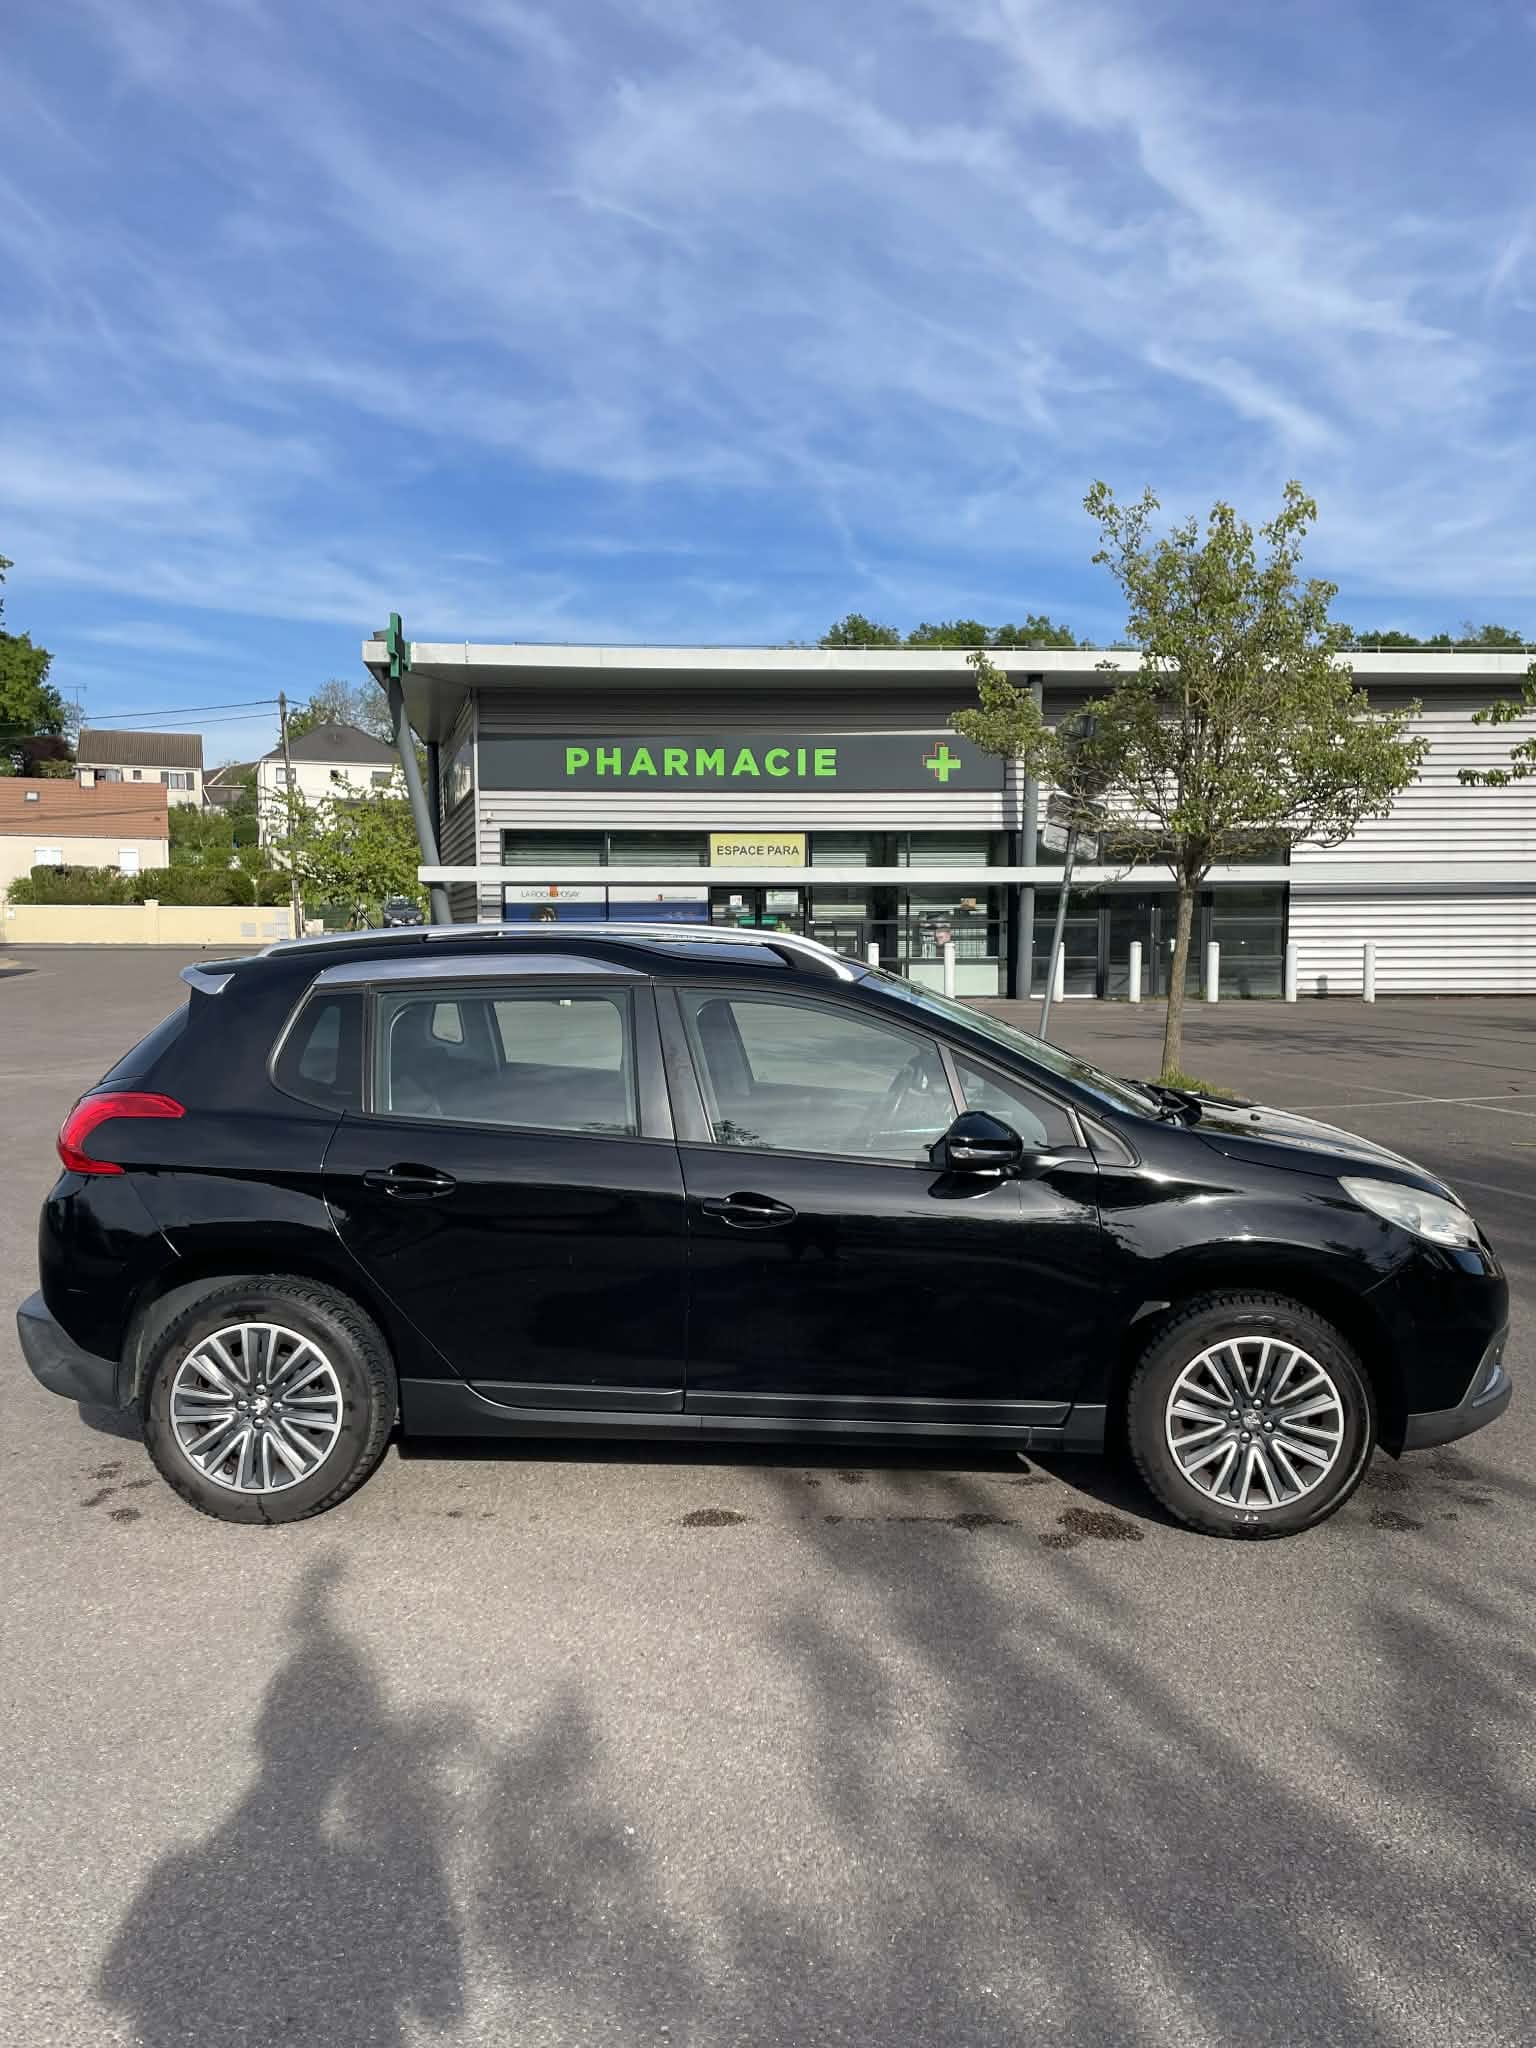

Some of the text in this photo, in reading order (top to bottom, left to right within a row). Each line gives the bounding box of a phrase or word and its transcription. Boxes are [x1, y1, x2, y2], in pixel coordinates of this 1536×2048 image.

[566, 747, 837, 777] PHARMACIE
[717, 845, 800, 856] ESPACE PARA
